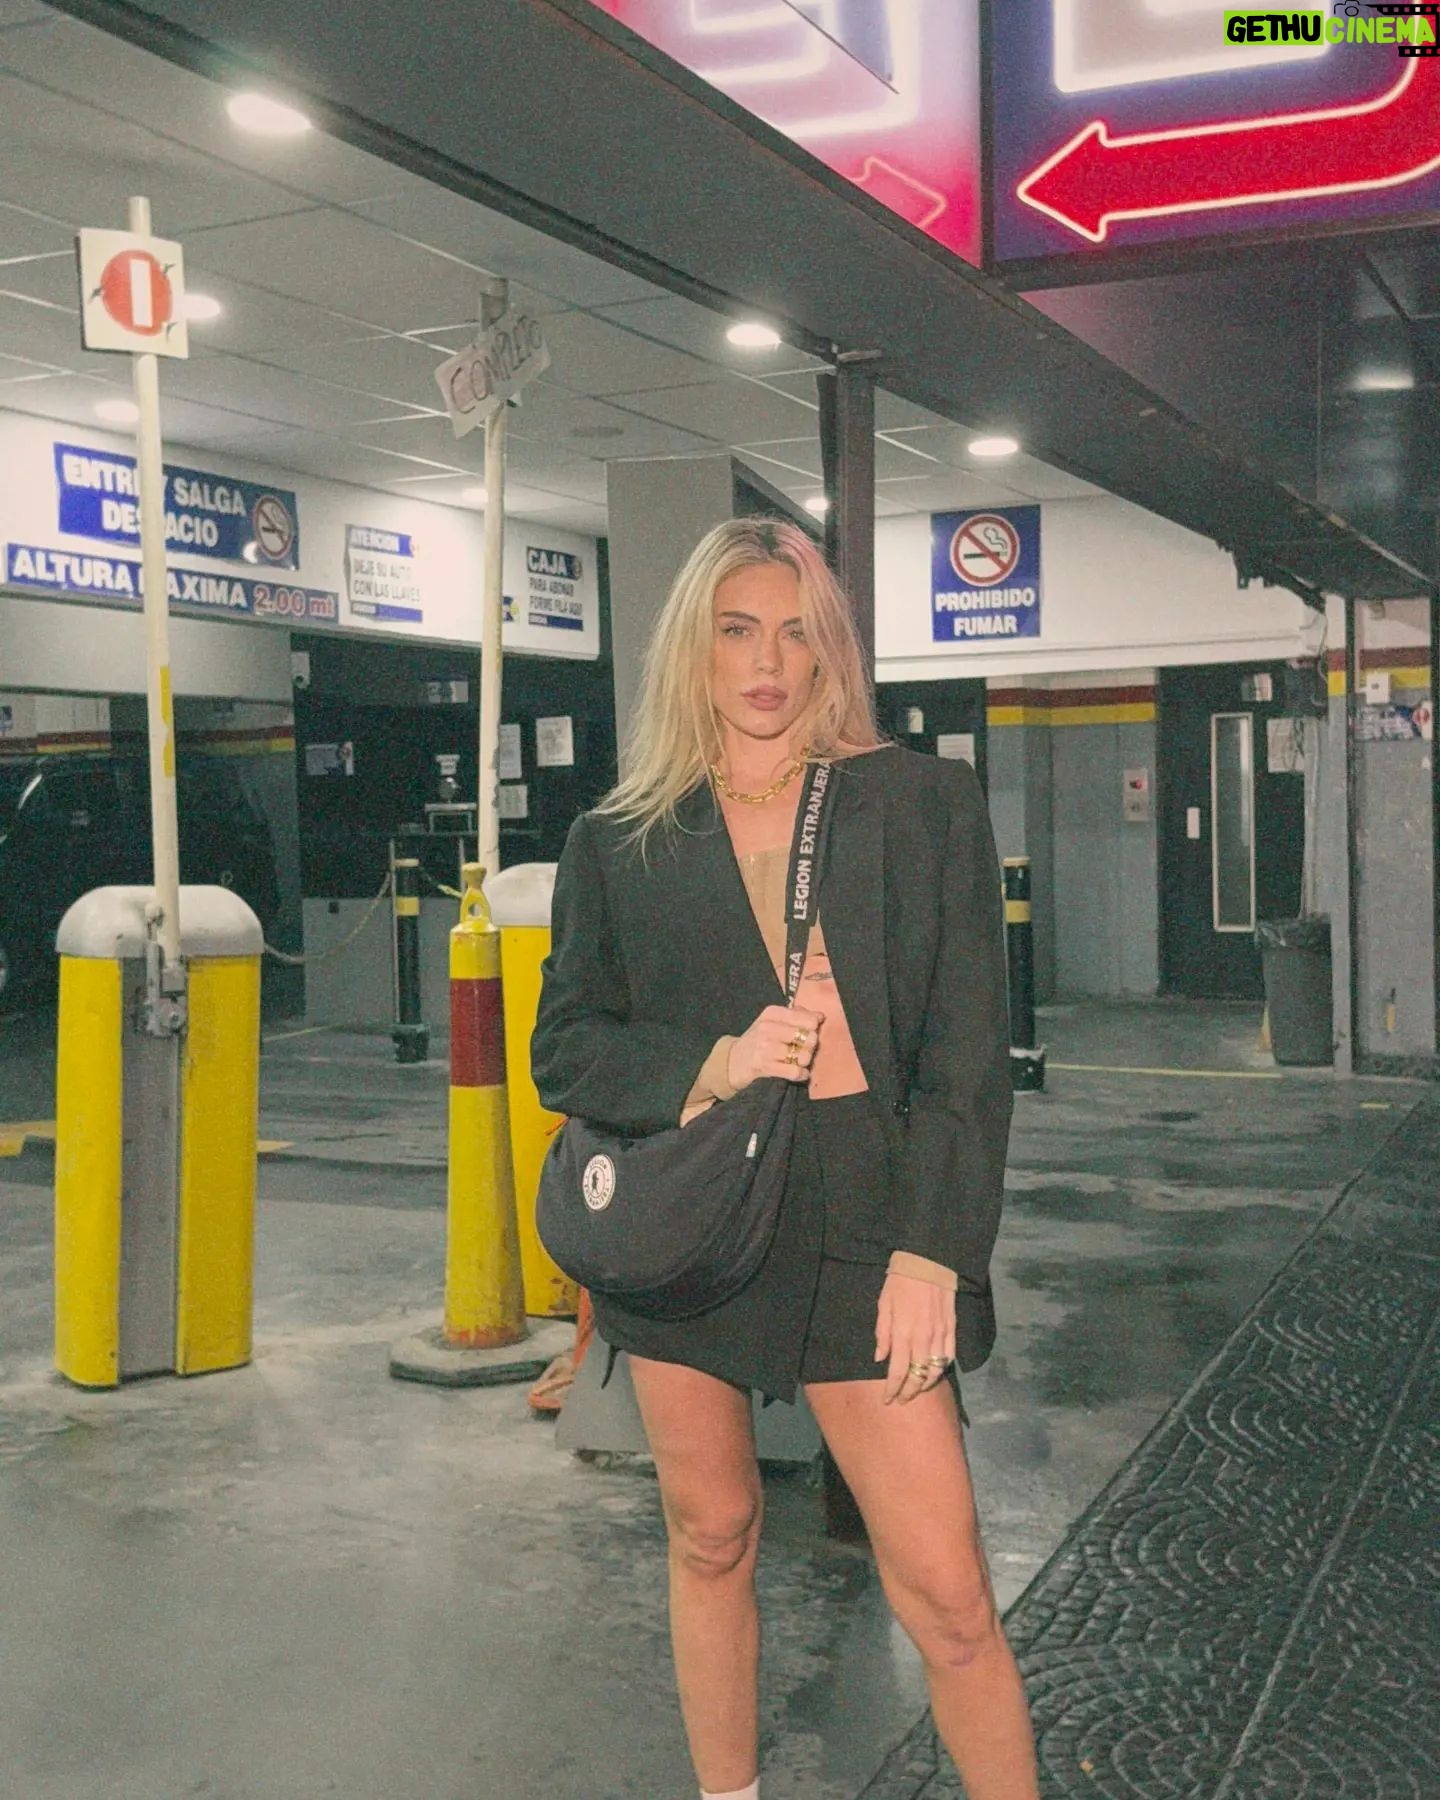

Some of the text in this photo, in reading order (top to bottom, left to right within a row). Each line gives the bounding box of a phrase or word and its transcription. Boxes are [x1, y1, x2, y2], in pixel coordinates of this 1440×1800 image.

[173, 477, 247, 516] SALGA
[528, 549, 568, 577] CAJA
[12, 547, 133, 592] ALTURA
[138, 567, 248, 609] AXIMA
[253, 584, 306, 616] 2.00
[935, 587, 1036, 612] PROHIBIDO
[953, 615, 1018, 637] FUMAR
[793, 759, 832, 921] LEGION EXTRANJERA
